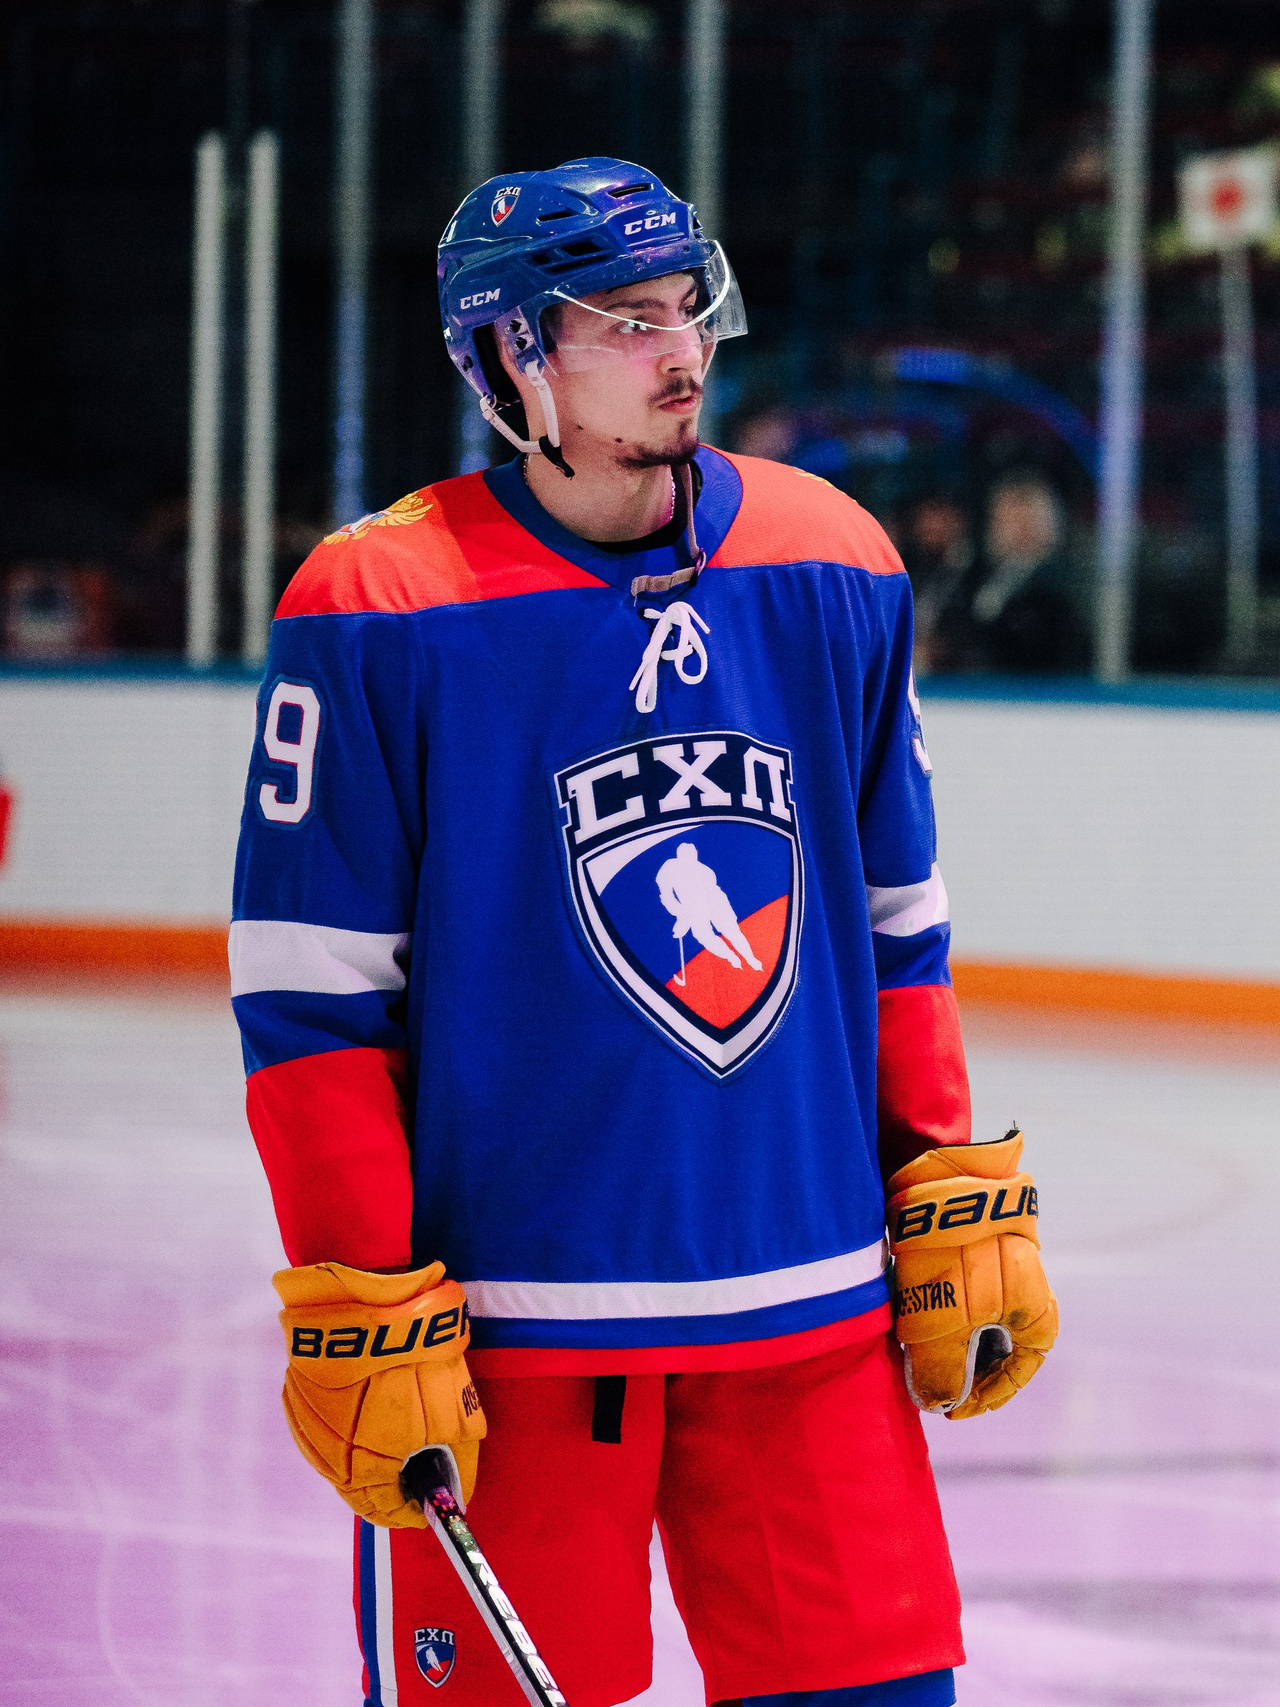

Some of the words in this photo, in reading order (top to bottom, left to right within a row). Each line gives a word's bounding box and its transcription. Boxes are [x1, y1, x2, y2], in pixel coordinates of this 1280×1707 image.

[624, 211, 677, 236] CCM
[459, 288, 501, 310] CCM
[259, 681, 321, 824] 9
